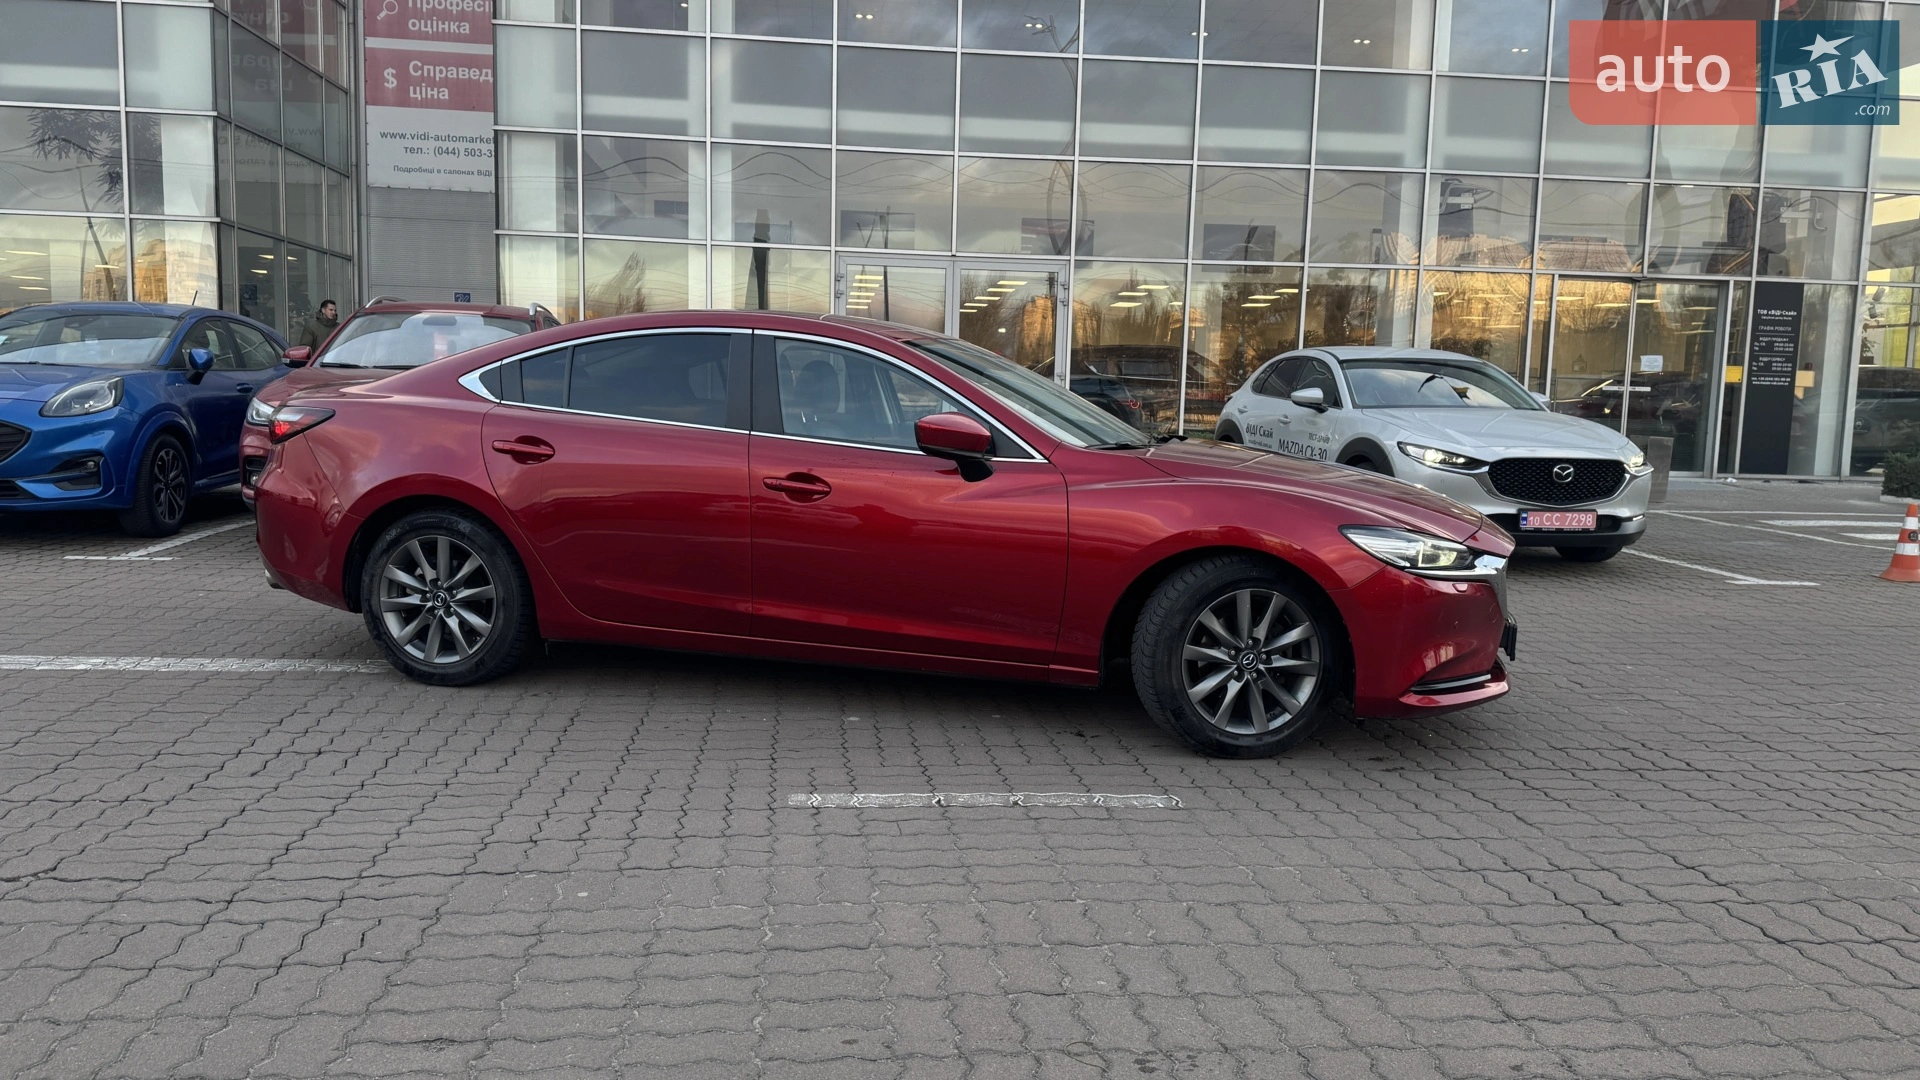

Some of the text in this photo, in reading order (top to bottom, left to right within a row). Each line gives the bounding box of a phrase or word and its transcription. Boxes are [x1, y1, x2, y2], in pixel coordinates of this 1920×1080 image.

[408, 16, 470, 35] оцінка
[409, 60, 493, 83] Справед
[409, 83, 449, 100] ціна
[403, 145, 495, 159] тел.: (044) 503-3
[393, 164, 435, 174] Подробиці
[1259, 426, 1273, 439] Скай
[1278, 438, 1304, 457] MAZDA
[1528, 513, 1593, 526] 10 CC 7298
